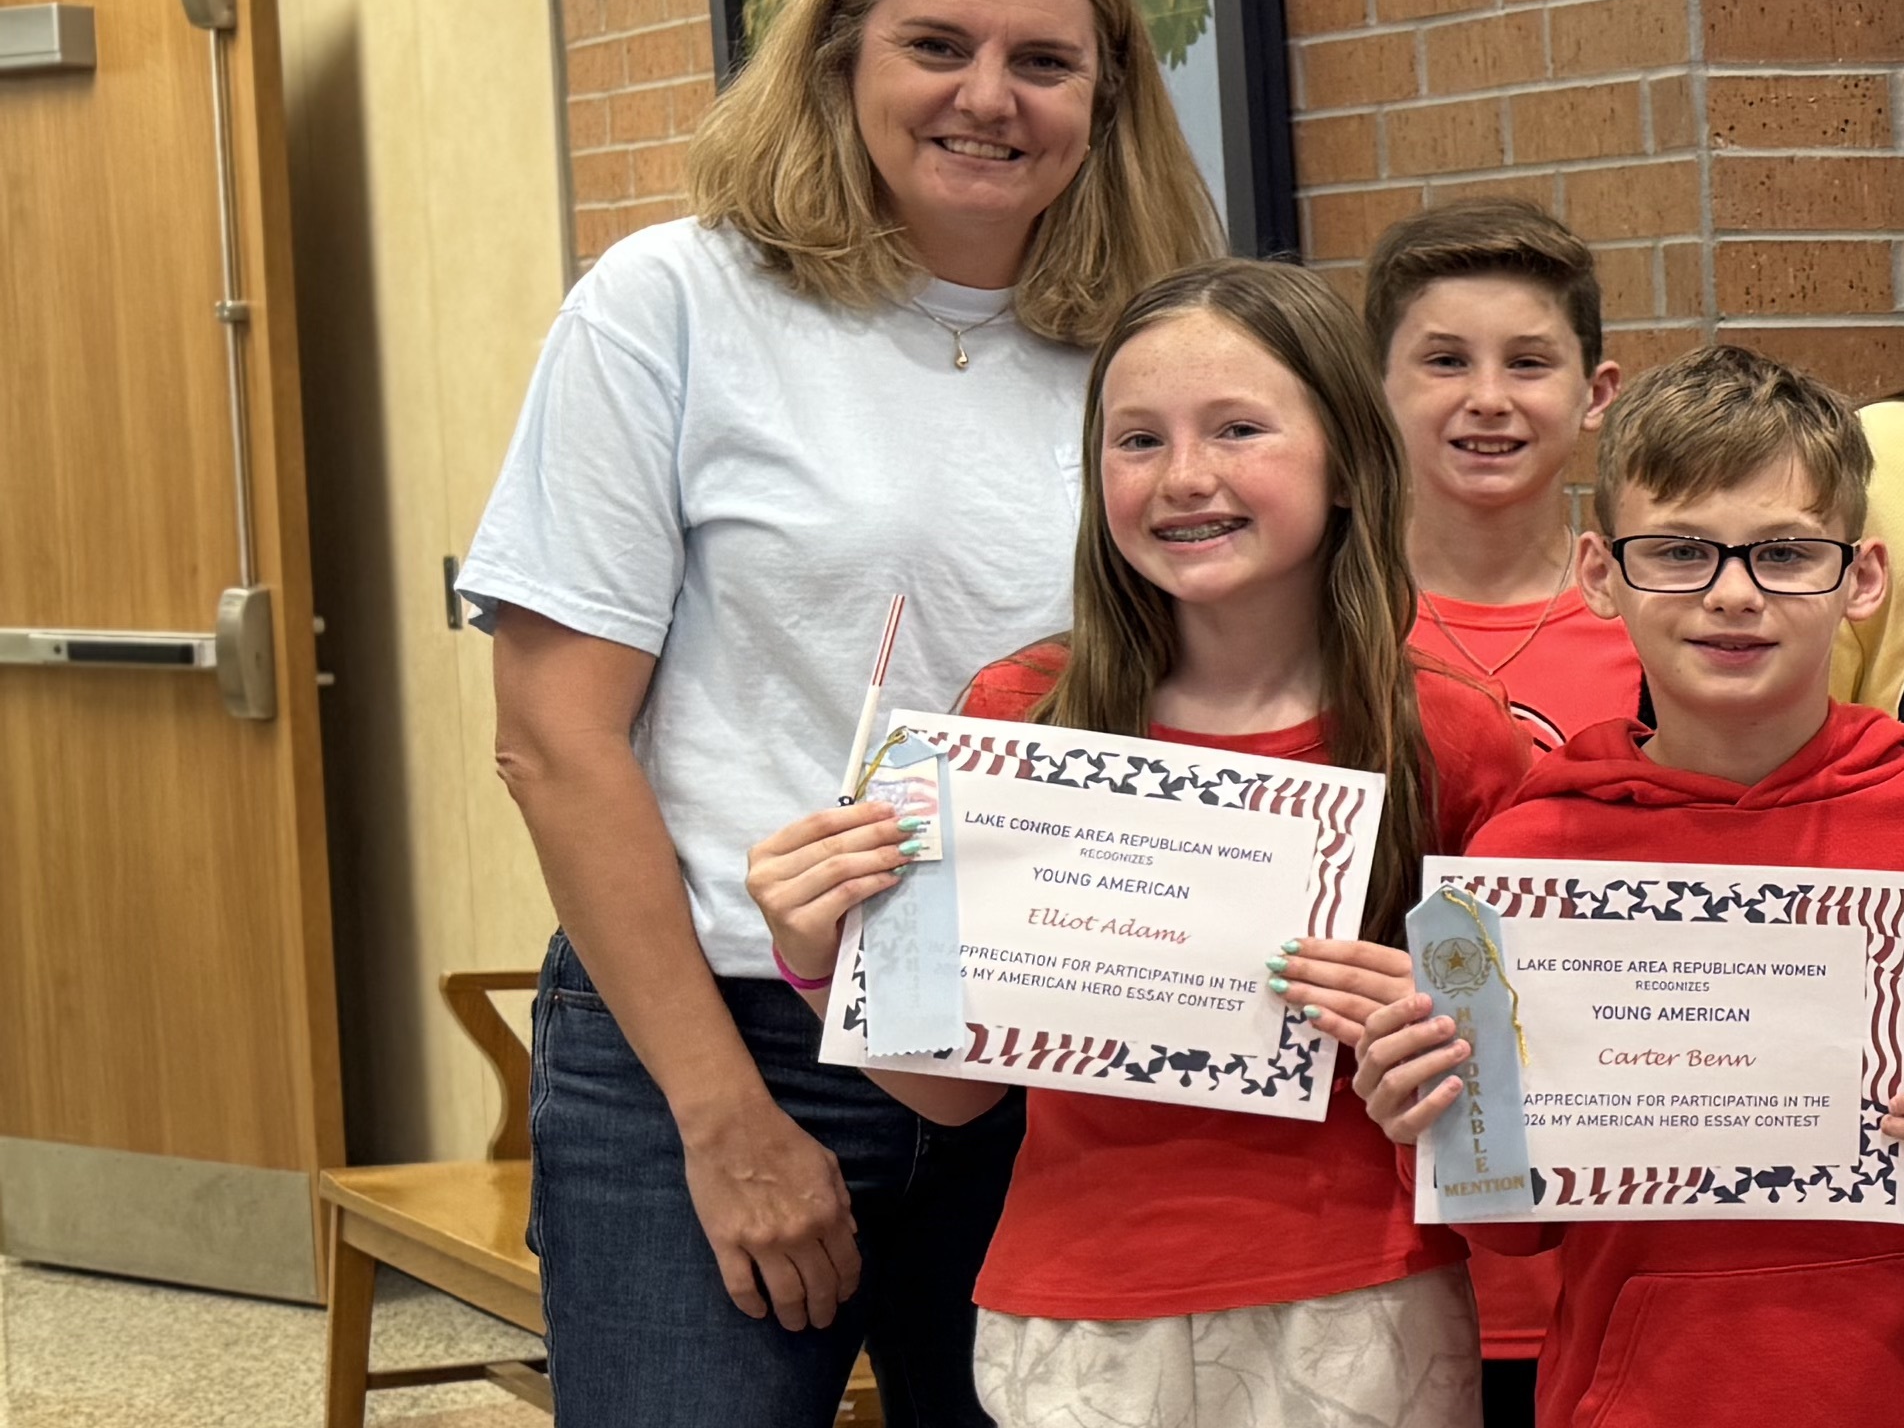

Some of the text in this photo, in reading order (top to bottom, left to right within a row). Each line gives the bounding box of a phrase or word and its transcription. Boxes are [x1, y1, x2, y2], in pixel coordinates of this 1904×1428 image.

[964, 810, 1273, 864] LAKE CONROE AREA REPUBLICAN WOMEN
[1033, 866, 1190, 900] YOUNG AMERICAN
[1027, 907, 1192, 945] Elliot Adams
[958, 944, 1058, 968] PPRECIATION
[1061, 957, 1092, 972] FOR
[1094, 961, 1205, 987] PARTICIPATING
[1209, 976, 1225, 990] IN
[1229, 977, 1258, 994] THE
[1516, 958, 1827, 977] LAKE CONROE AREA REPUBLICAN WOMEN
[972, 967, 995, 981] MY
[996, 970, 1077, 991] AMERICAN
[1081, 980, 1123, 997] HERO
[1126, 986, 1175, 1003] ESSAY
[1177, 992, 1245, 1012] CONTEST
[1635, 980, 1710, 992] RECOGNIZES
[1592, 1005, 1750, 1022] YOUNG AMERICAN
[1598, 1048, 1757, 1067] Carter Benn
[1523, 1093, 1830, 1108] APPRECIATION FOR PARTICIPATING IN THE
[1551, 1114, 1573, 1126] MY
[1576, 1114, 1655, 1127] AMERICAN
[1659, 1114, 1699, 1127] HERO
[1704, 1114, 1751, 1127] ESSAY
[1754, 1114, 1821, 1128] CONTEST
[1444, 1174, 1526, 1197] MENTION
